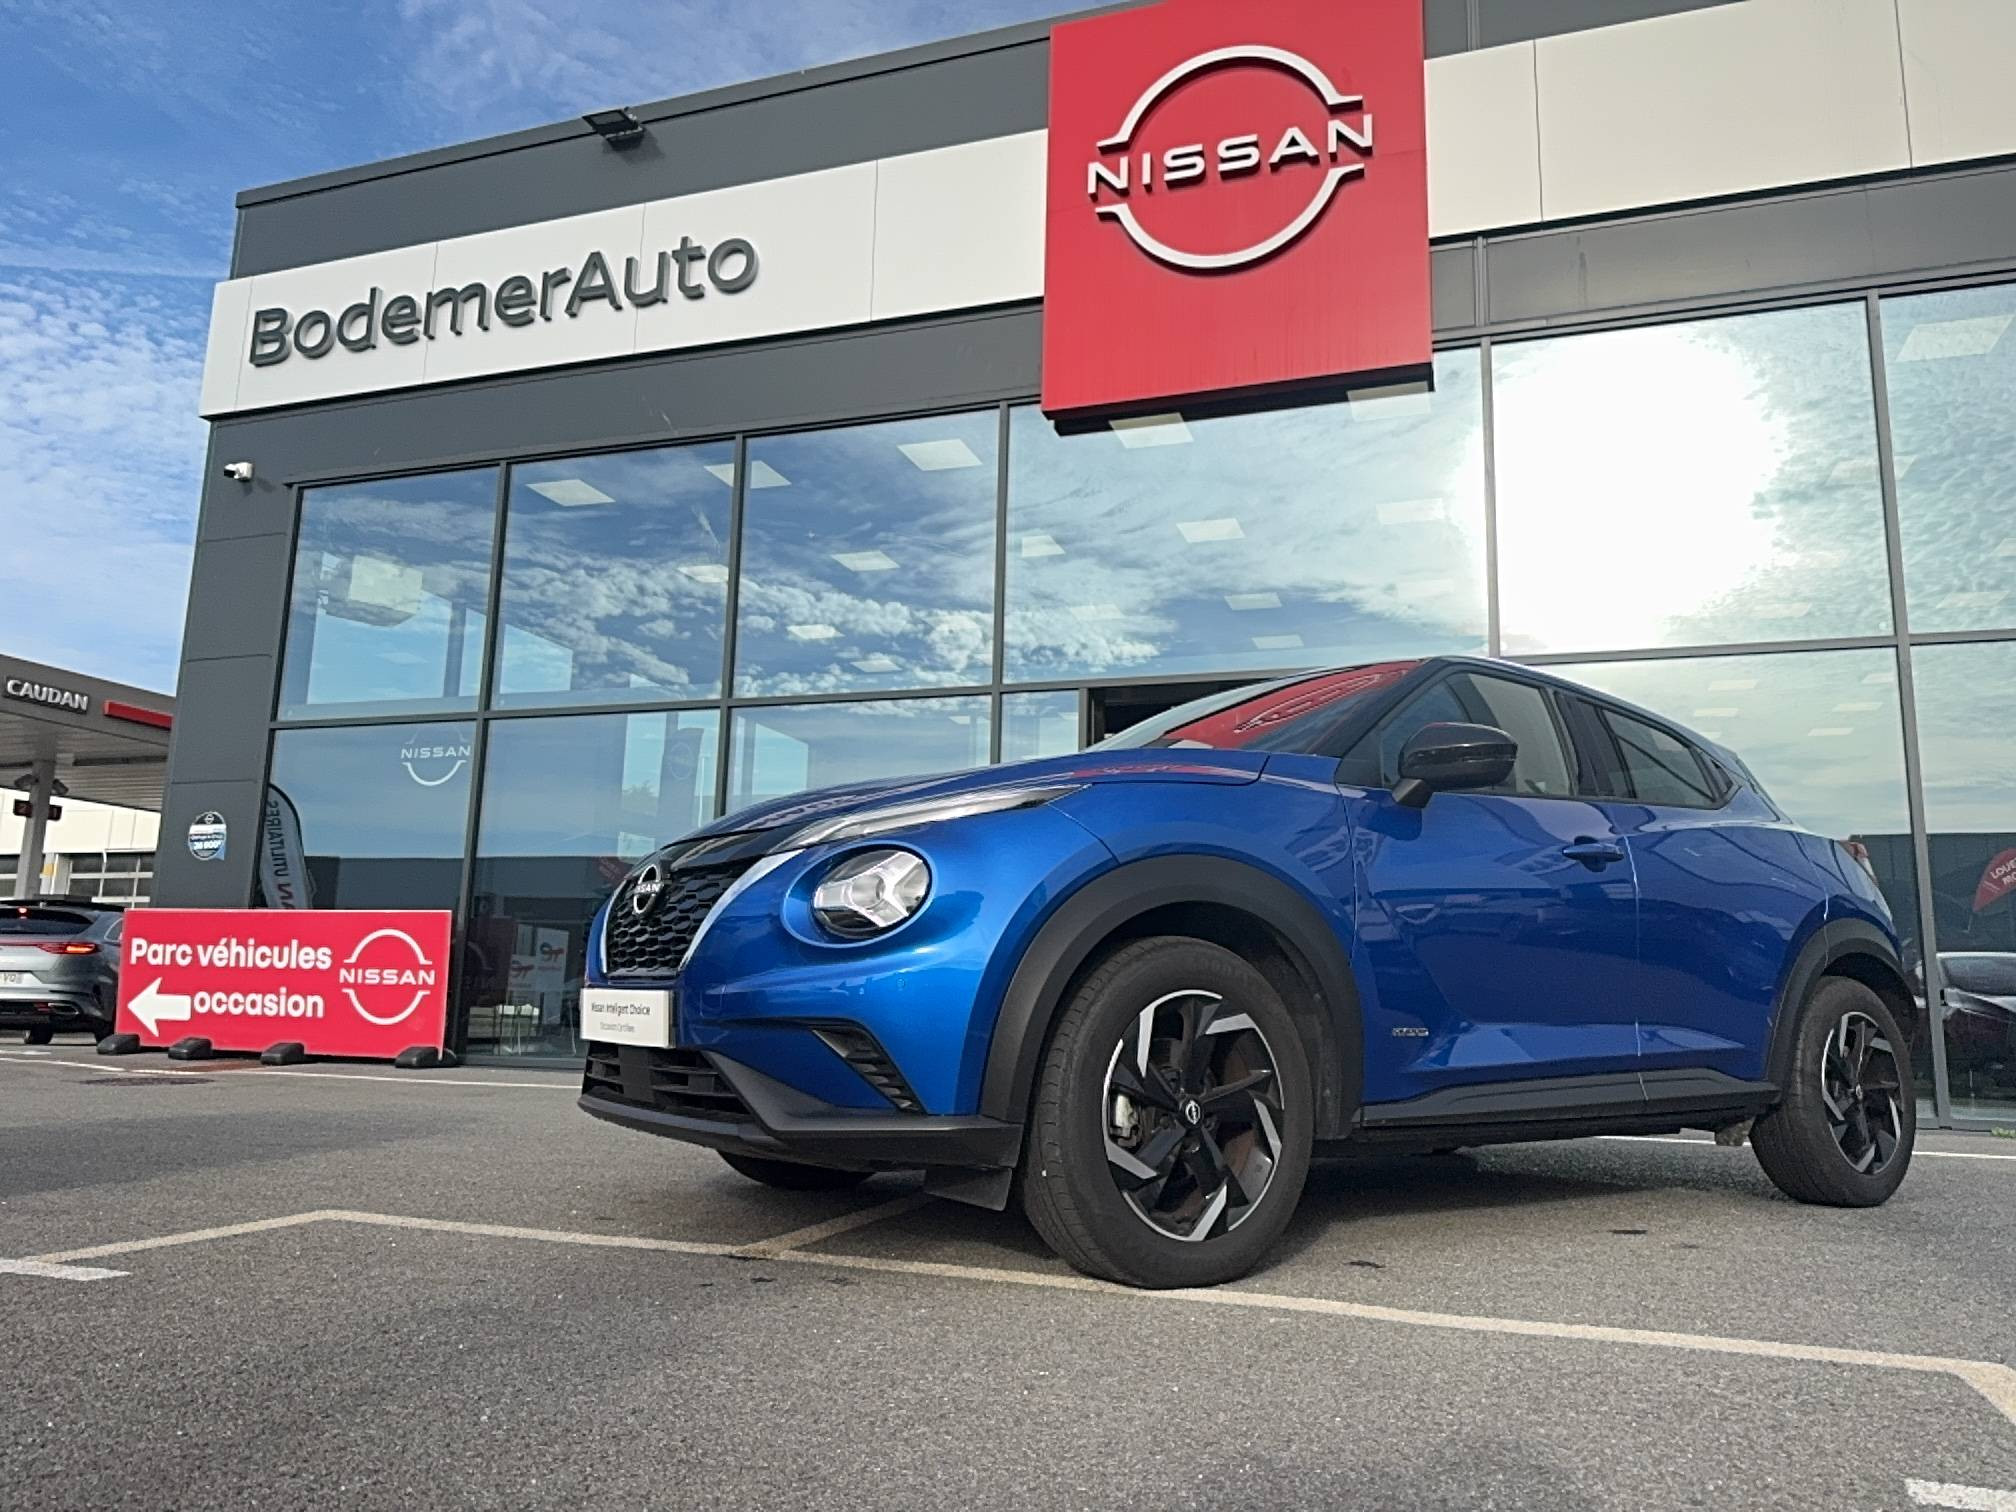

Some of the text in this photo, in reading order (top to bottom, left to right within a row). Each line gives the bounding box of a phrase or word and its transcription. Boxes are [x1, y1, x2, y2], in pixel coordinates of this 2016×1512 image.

[1088, 113, 1373, 201] NISSAN
[249, 236, 758, 367] BodemerAuto
[7, 679, 88, 711] CAUDAN
[401, 745, 471, 759] NISSAN
[130, 938, 332, 970] Parc véhicules
[339, 968, 436, 985] NISSAN
[193, 986, 324, 1018] occasion
[629, 1002, 651, 1016] Choice
